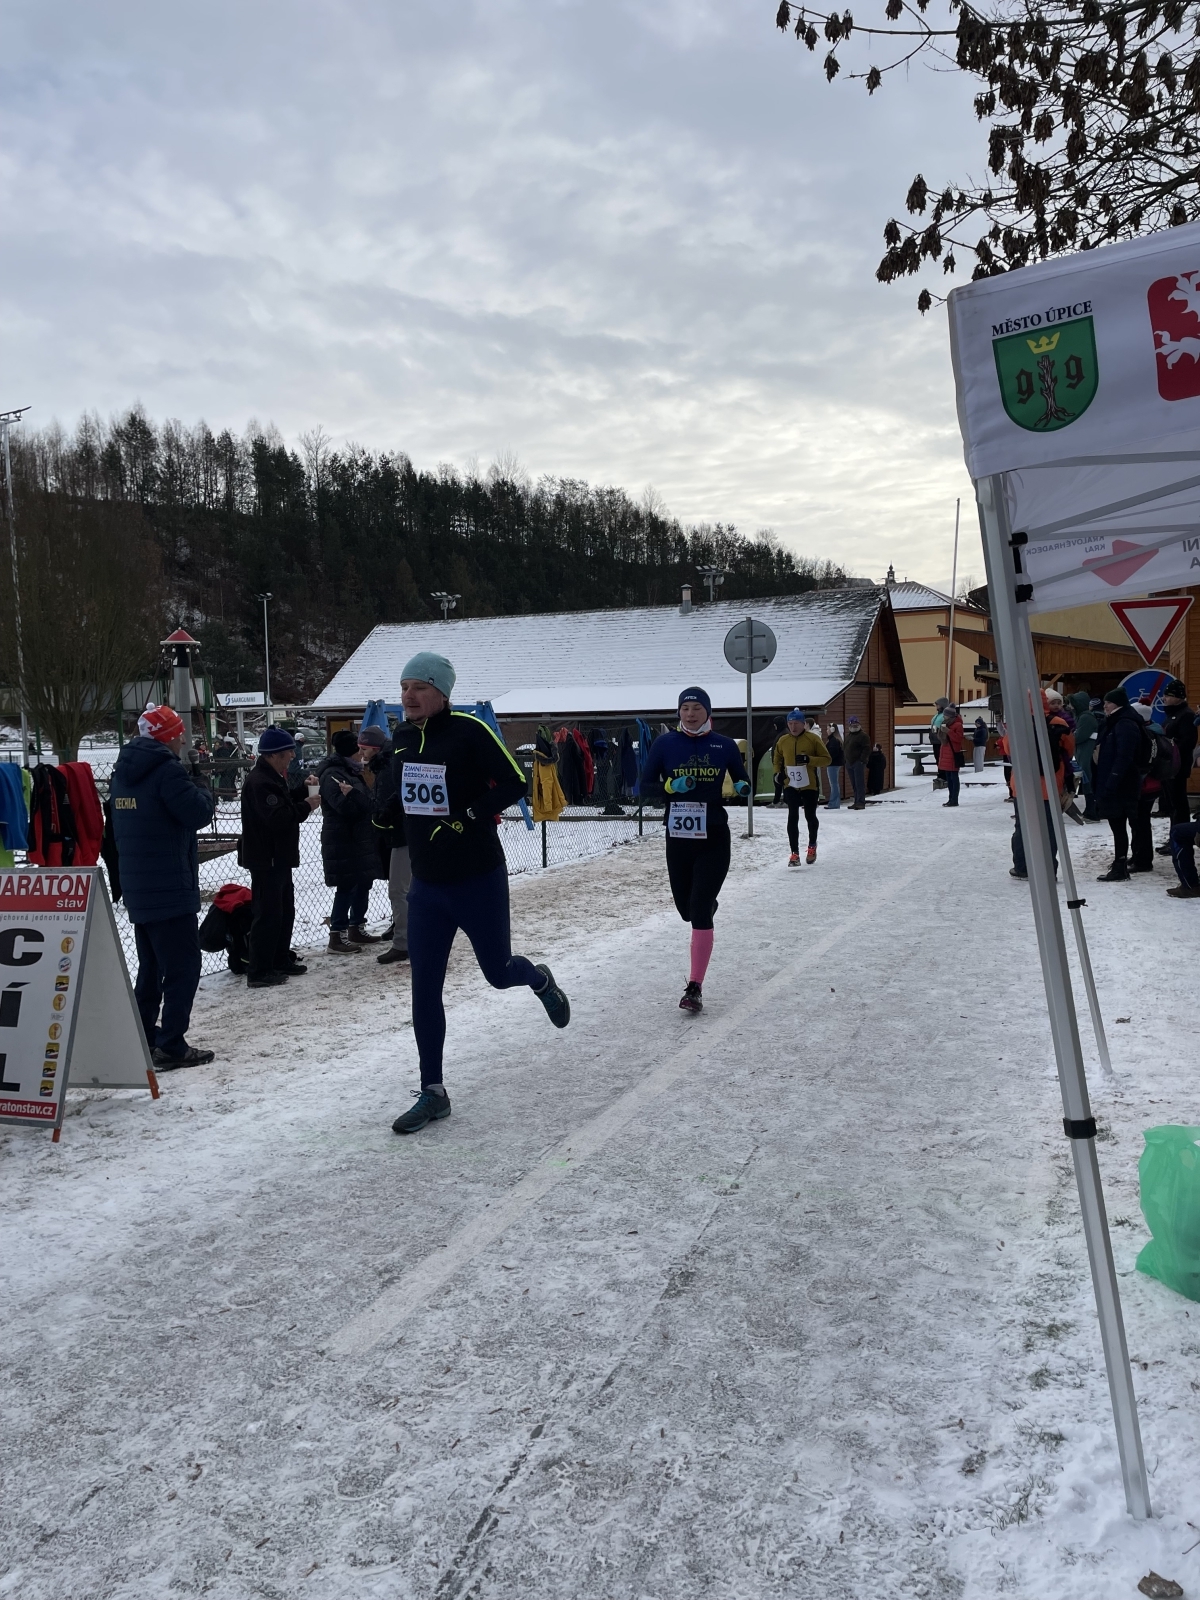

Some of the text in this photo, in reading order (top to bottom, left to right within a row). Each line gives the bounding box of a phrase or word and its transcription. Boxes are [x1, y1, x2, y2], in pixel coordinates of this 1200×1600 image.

[991, 300, 1093, 337] MĚSTO ÚPICE
[672, 767, 721, 777] TRUTNOV
[403, 782, 445, 805] 306
[673, 816, 701, 831] 301
[0, 874, 91, 897] ARATON
[56, 898, 84, 908] stav
[32, 914, 60, 922] jednota
[63, 913, 86, 922] Úpice
